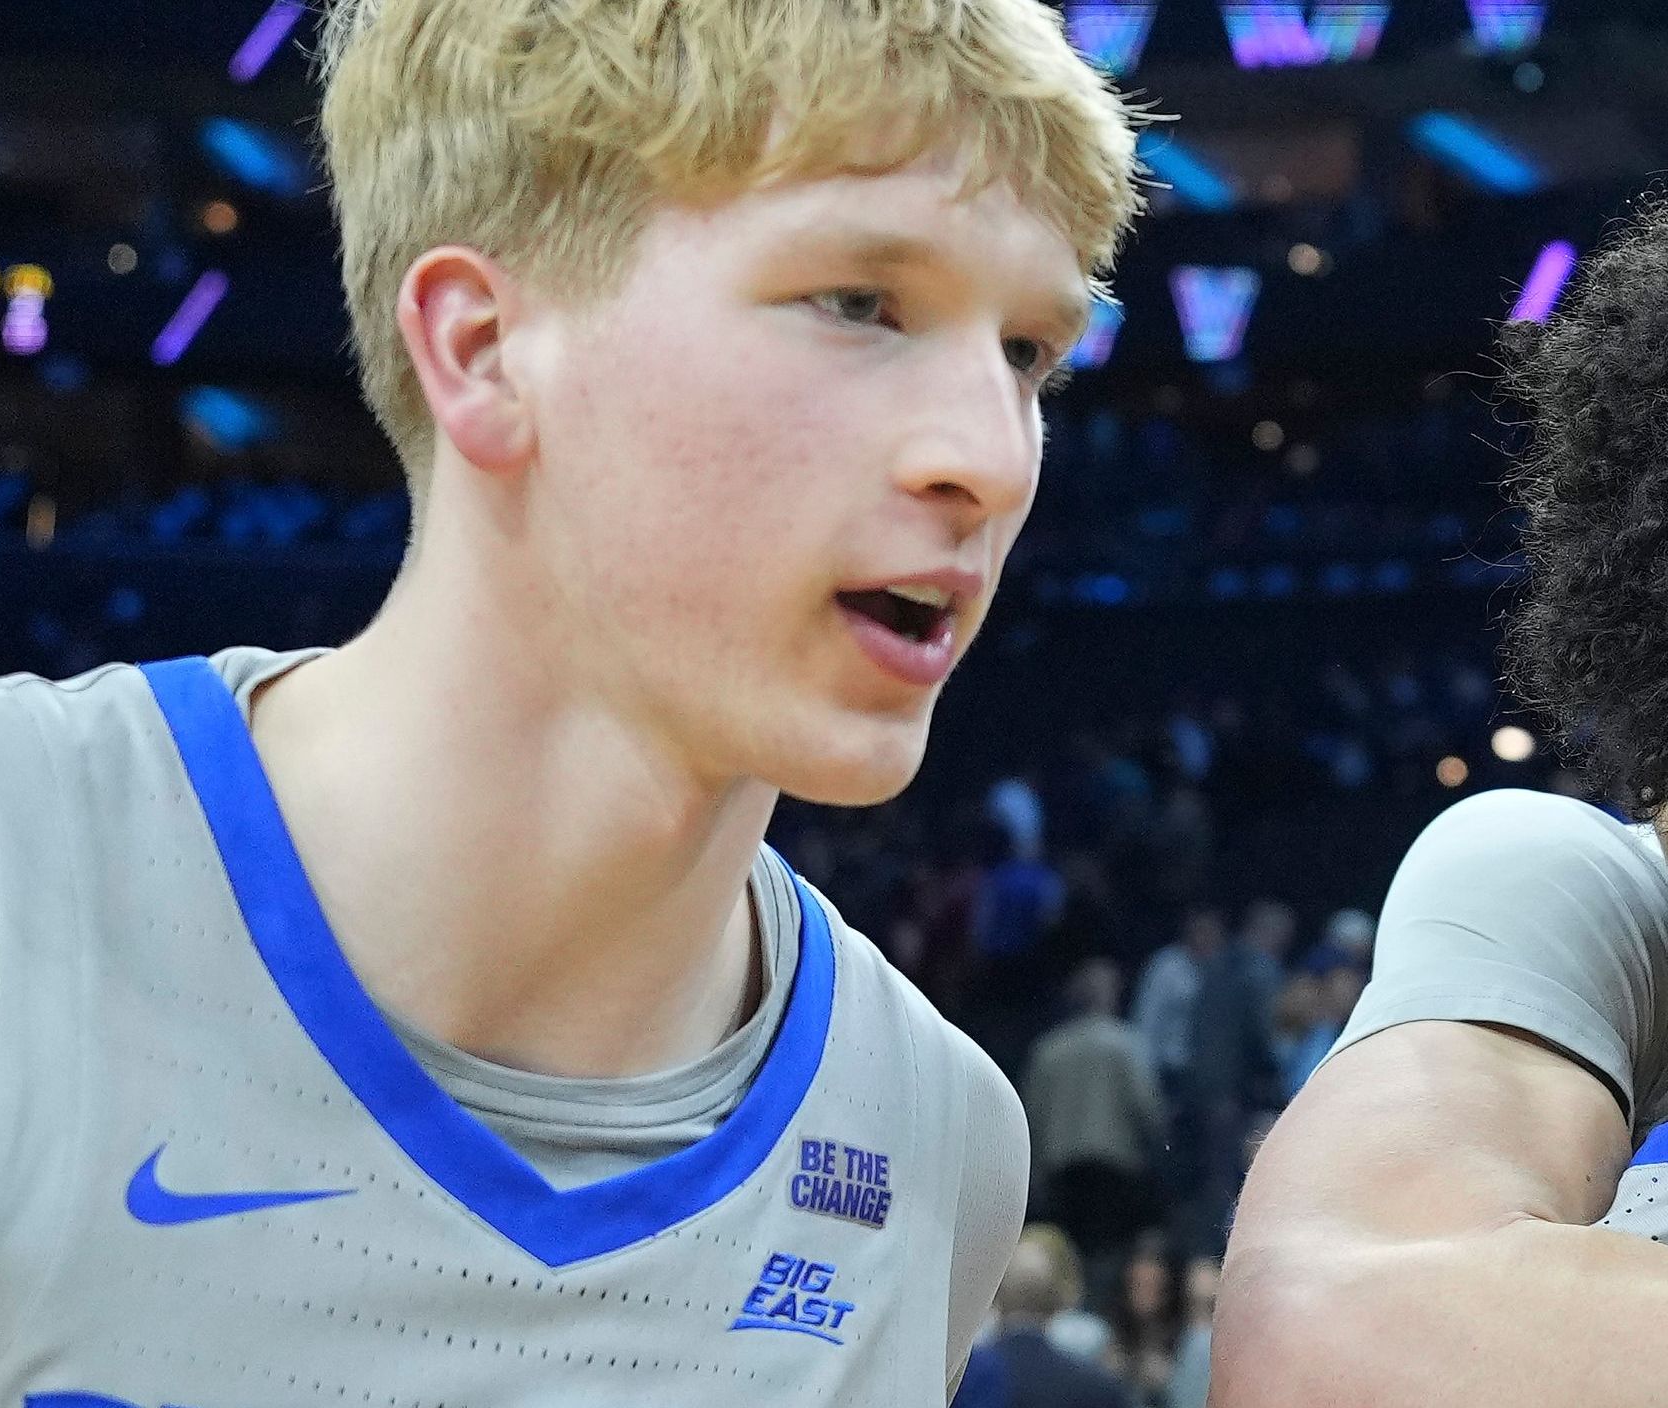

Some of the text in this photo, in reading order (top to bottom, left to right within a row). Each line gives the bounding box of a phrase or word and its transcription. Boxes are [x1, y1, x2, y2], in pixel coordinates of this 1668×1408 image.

[800, 1140, 888, 1187] BE THE
[791, 1174, 892, 1225] CHANGE
[760, 1252, 835, 1293] BIG
[741, 1285, 855, 1328] EAST
